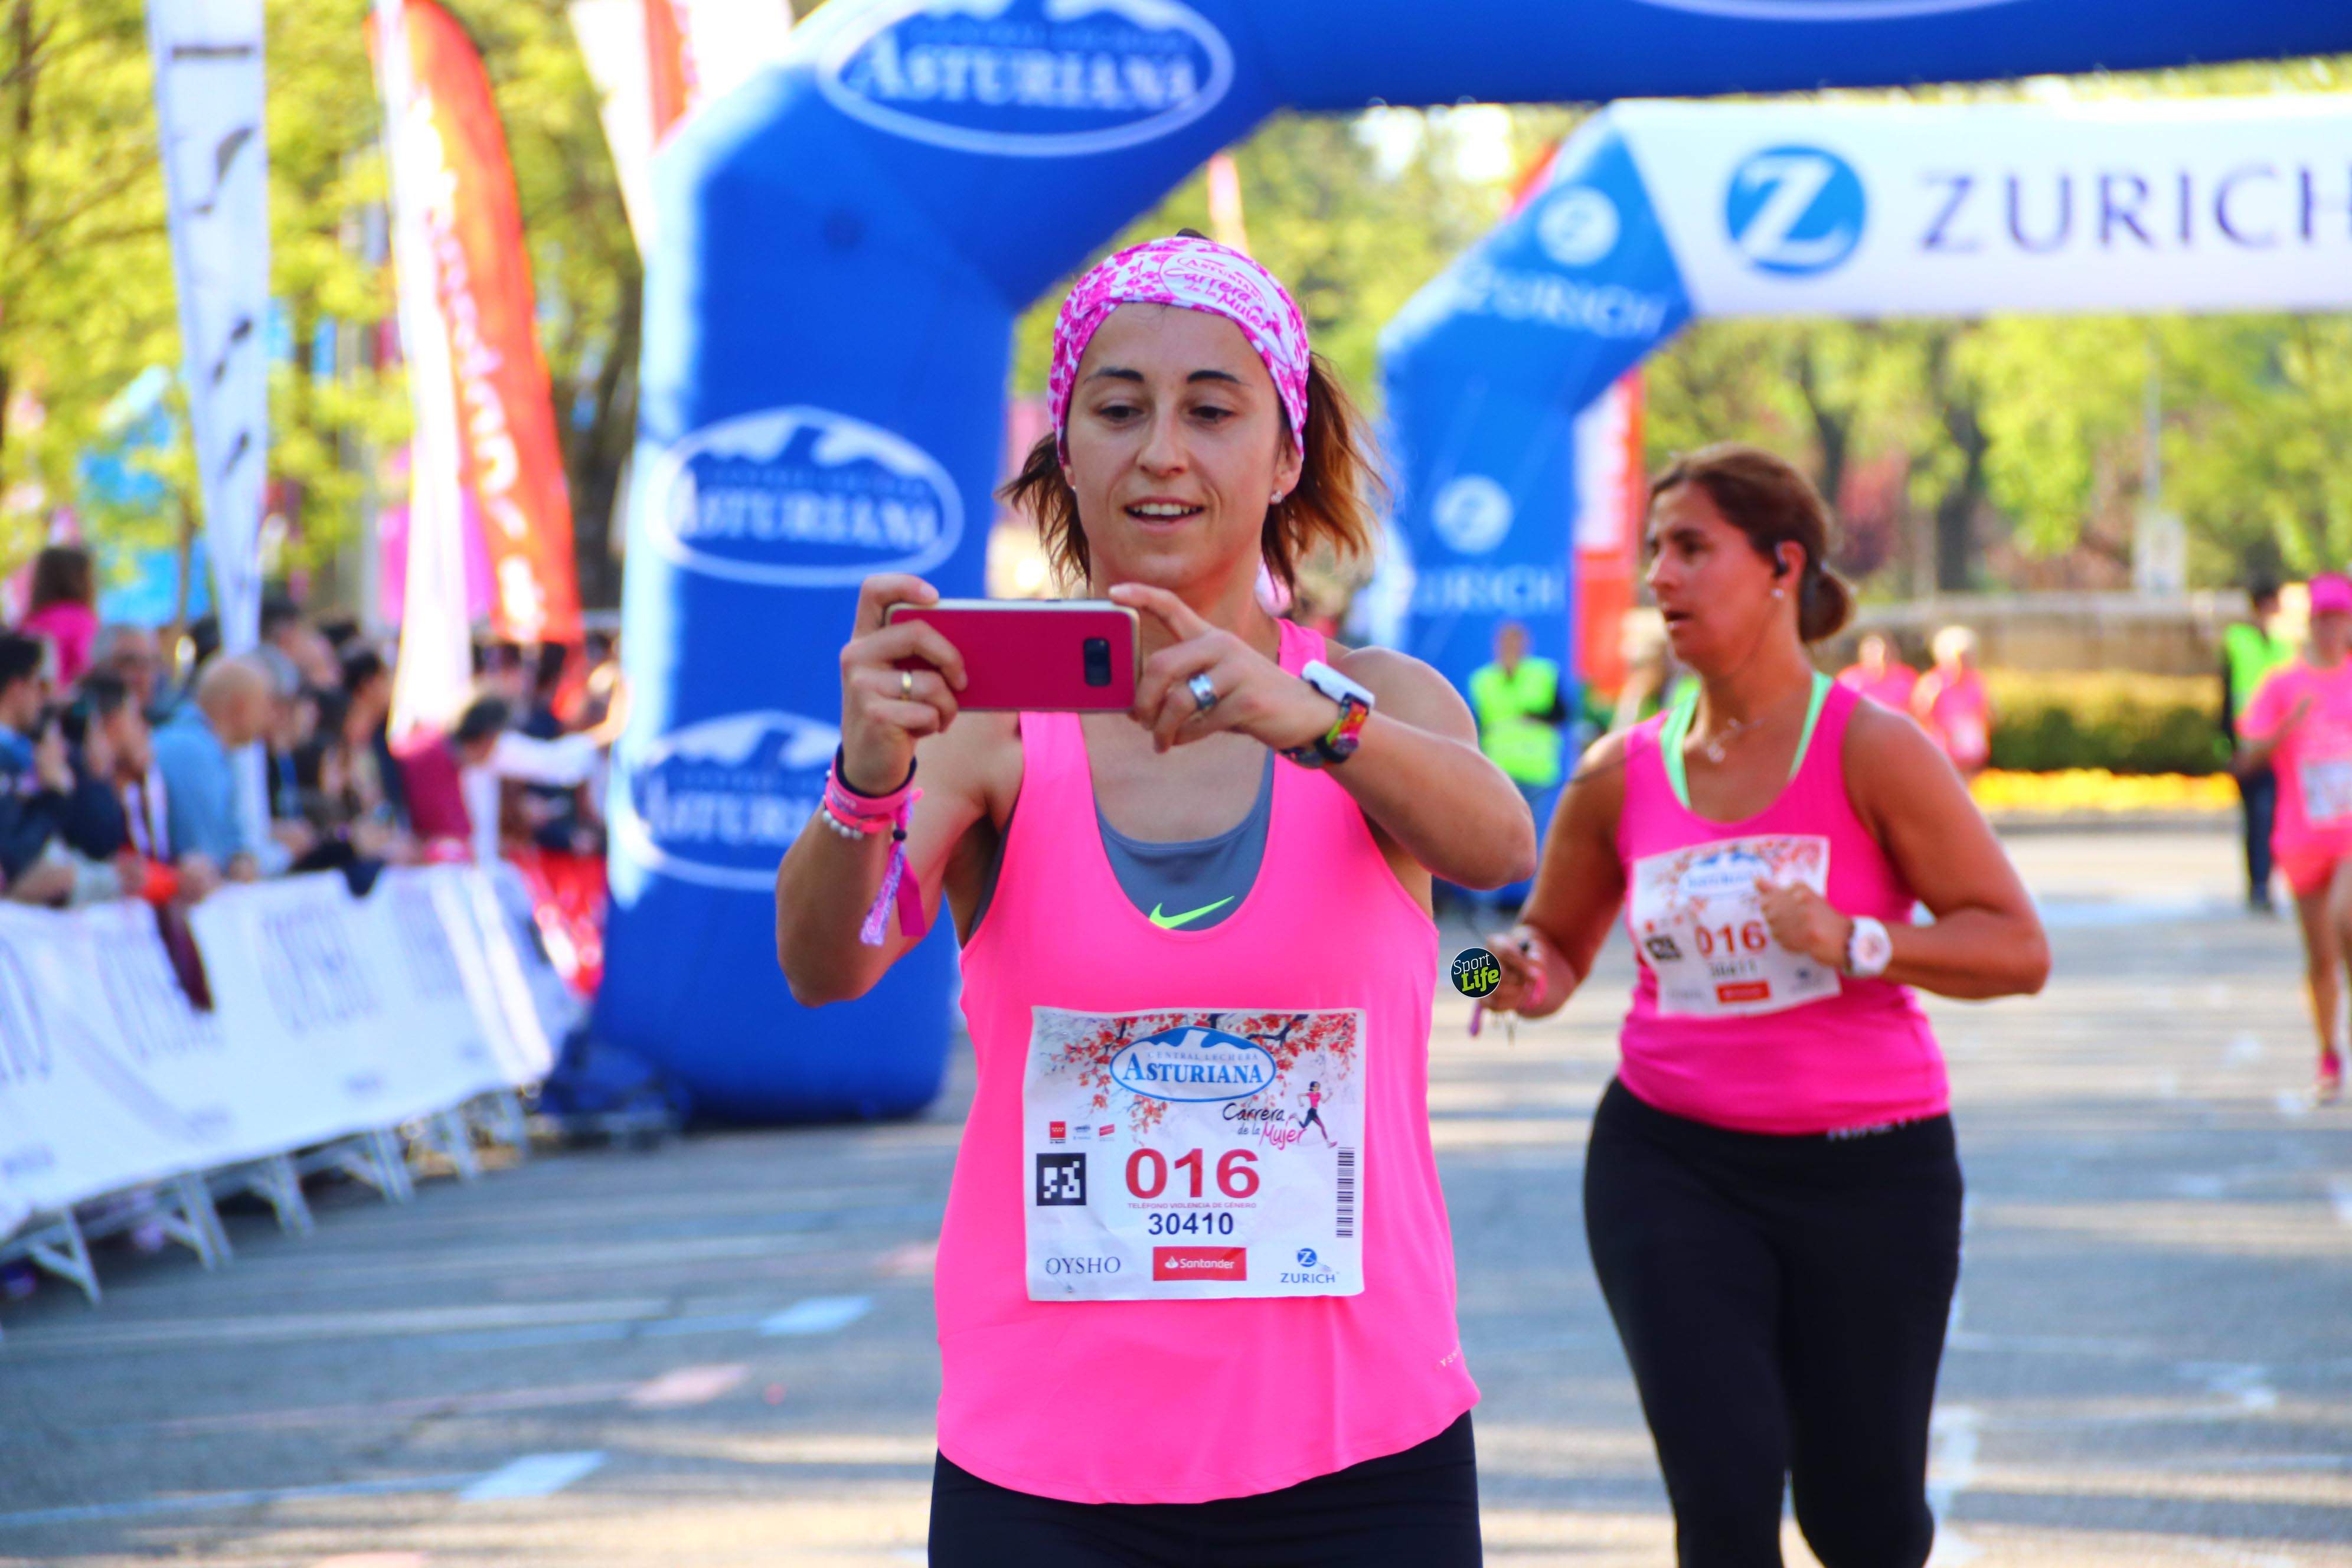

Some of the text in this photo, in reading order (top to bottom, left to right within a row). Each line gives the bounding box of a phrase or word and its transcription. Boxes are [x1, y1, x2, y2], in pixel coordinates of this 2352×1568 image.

[1917, 164, 2352, 255] ZURICH
[1694, 921, 1766, 957] 016
[1122, 1052, 1263, 1083] ASTURIANA
[1147, 1051, 1259, 1061] CENTRAL LECHERA
[1223, 1102, 1285, 1121] Carrera
[1237, 1121, 1307, 1151] de la Mujer
[1125, 1148, 1260, 1199] 016
[1148, 1212, 1233, 1235] 30410
[1046, 1256, 1121, 1275] OYSHO
[1180, 1258, 1234, 1269] Santander
[1280, 1272, 1335, 1283] ZURICH
